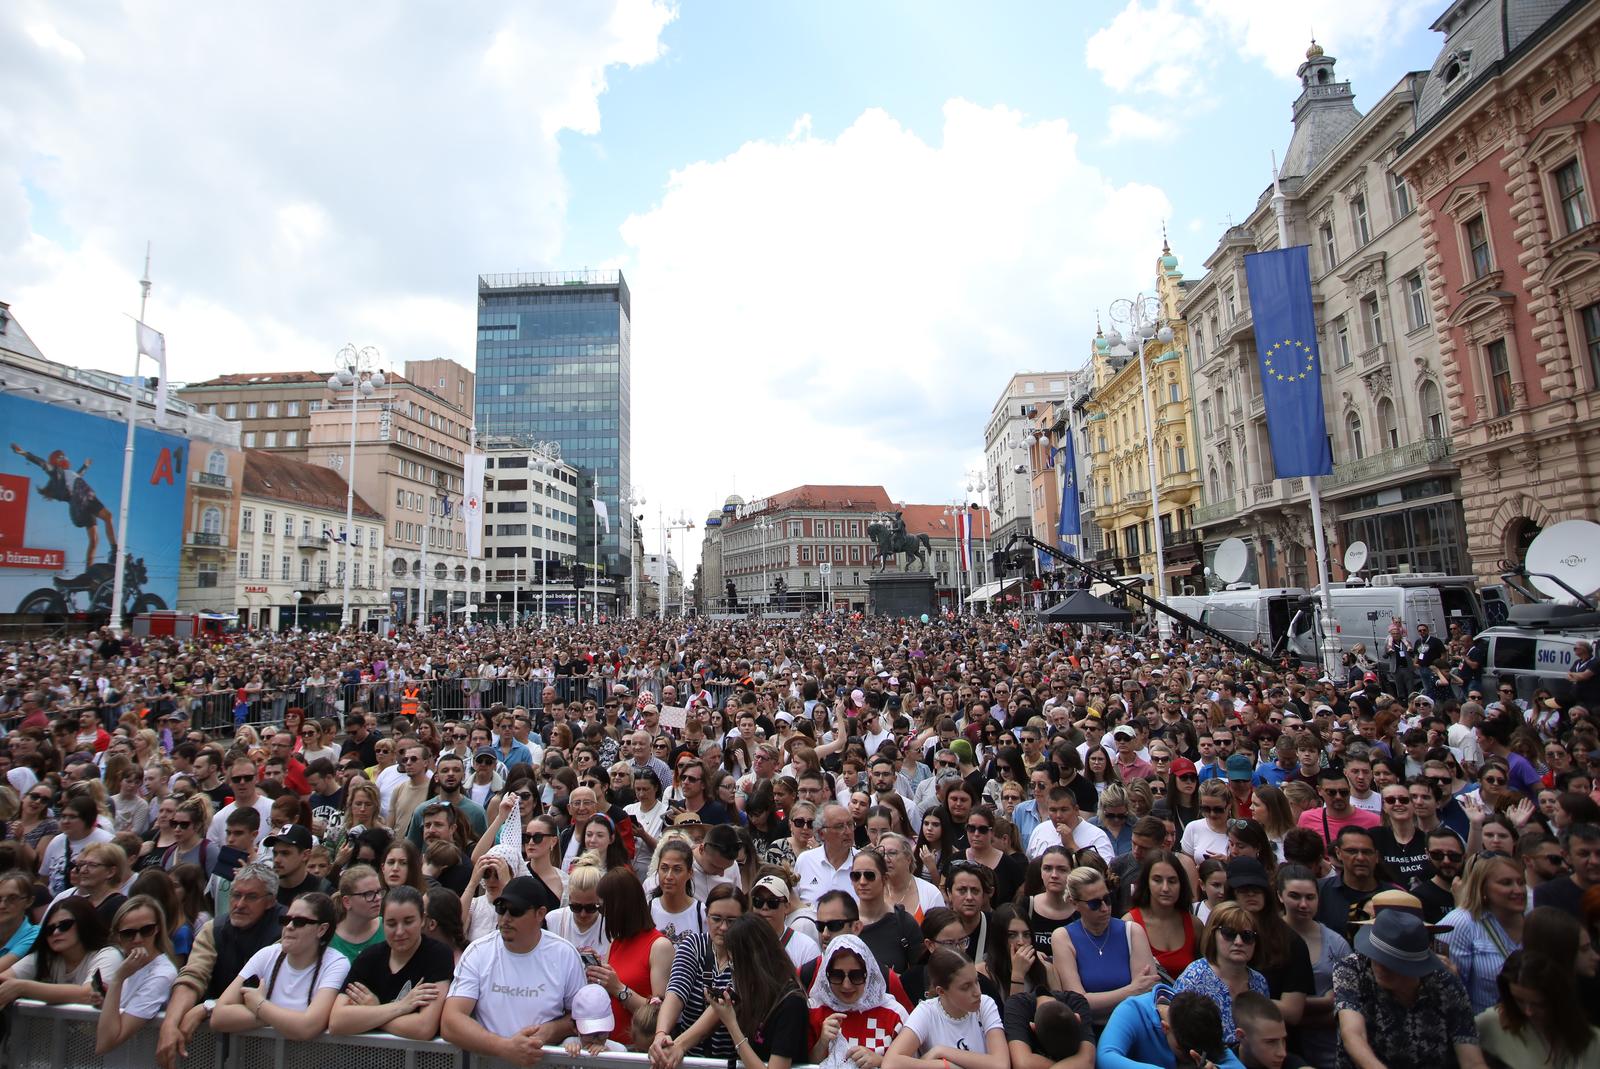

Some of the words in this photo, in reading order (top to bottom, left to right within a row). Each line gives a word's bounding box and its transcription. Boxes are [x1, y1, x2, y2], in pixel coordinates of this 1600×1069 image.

[150, 446, 183, 486] A1
[1559, 557, 1587, 565] ADVENT
[1537, 648, 1556, 663] SNG
[1560, 650, 1572, 665] 10
[1410, 854, 1429, 863] MEO
[1400, 864, 1423, 873] BACK
